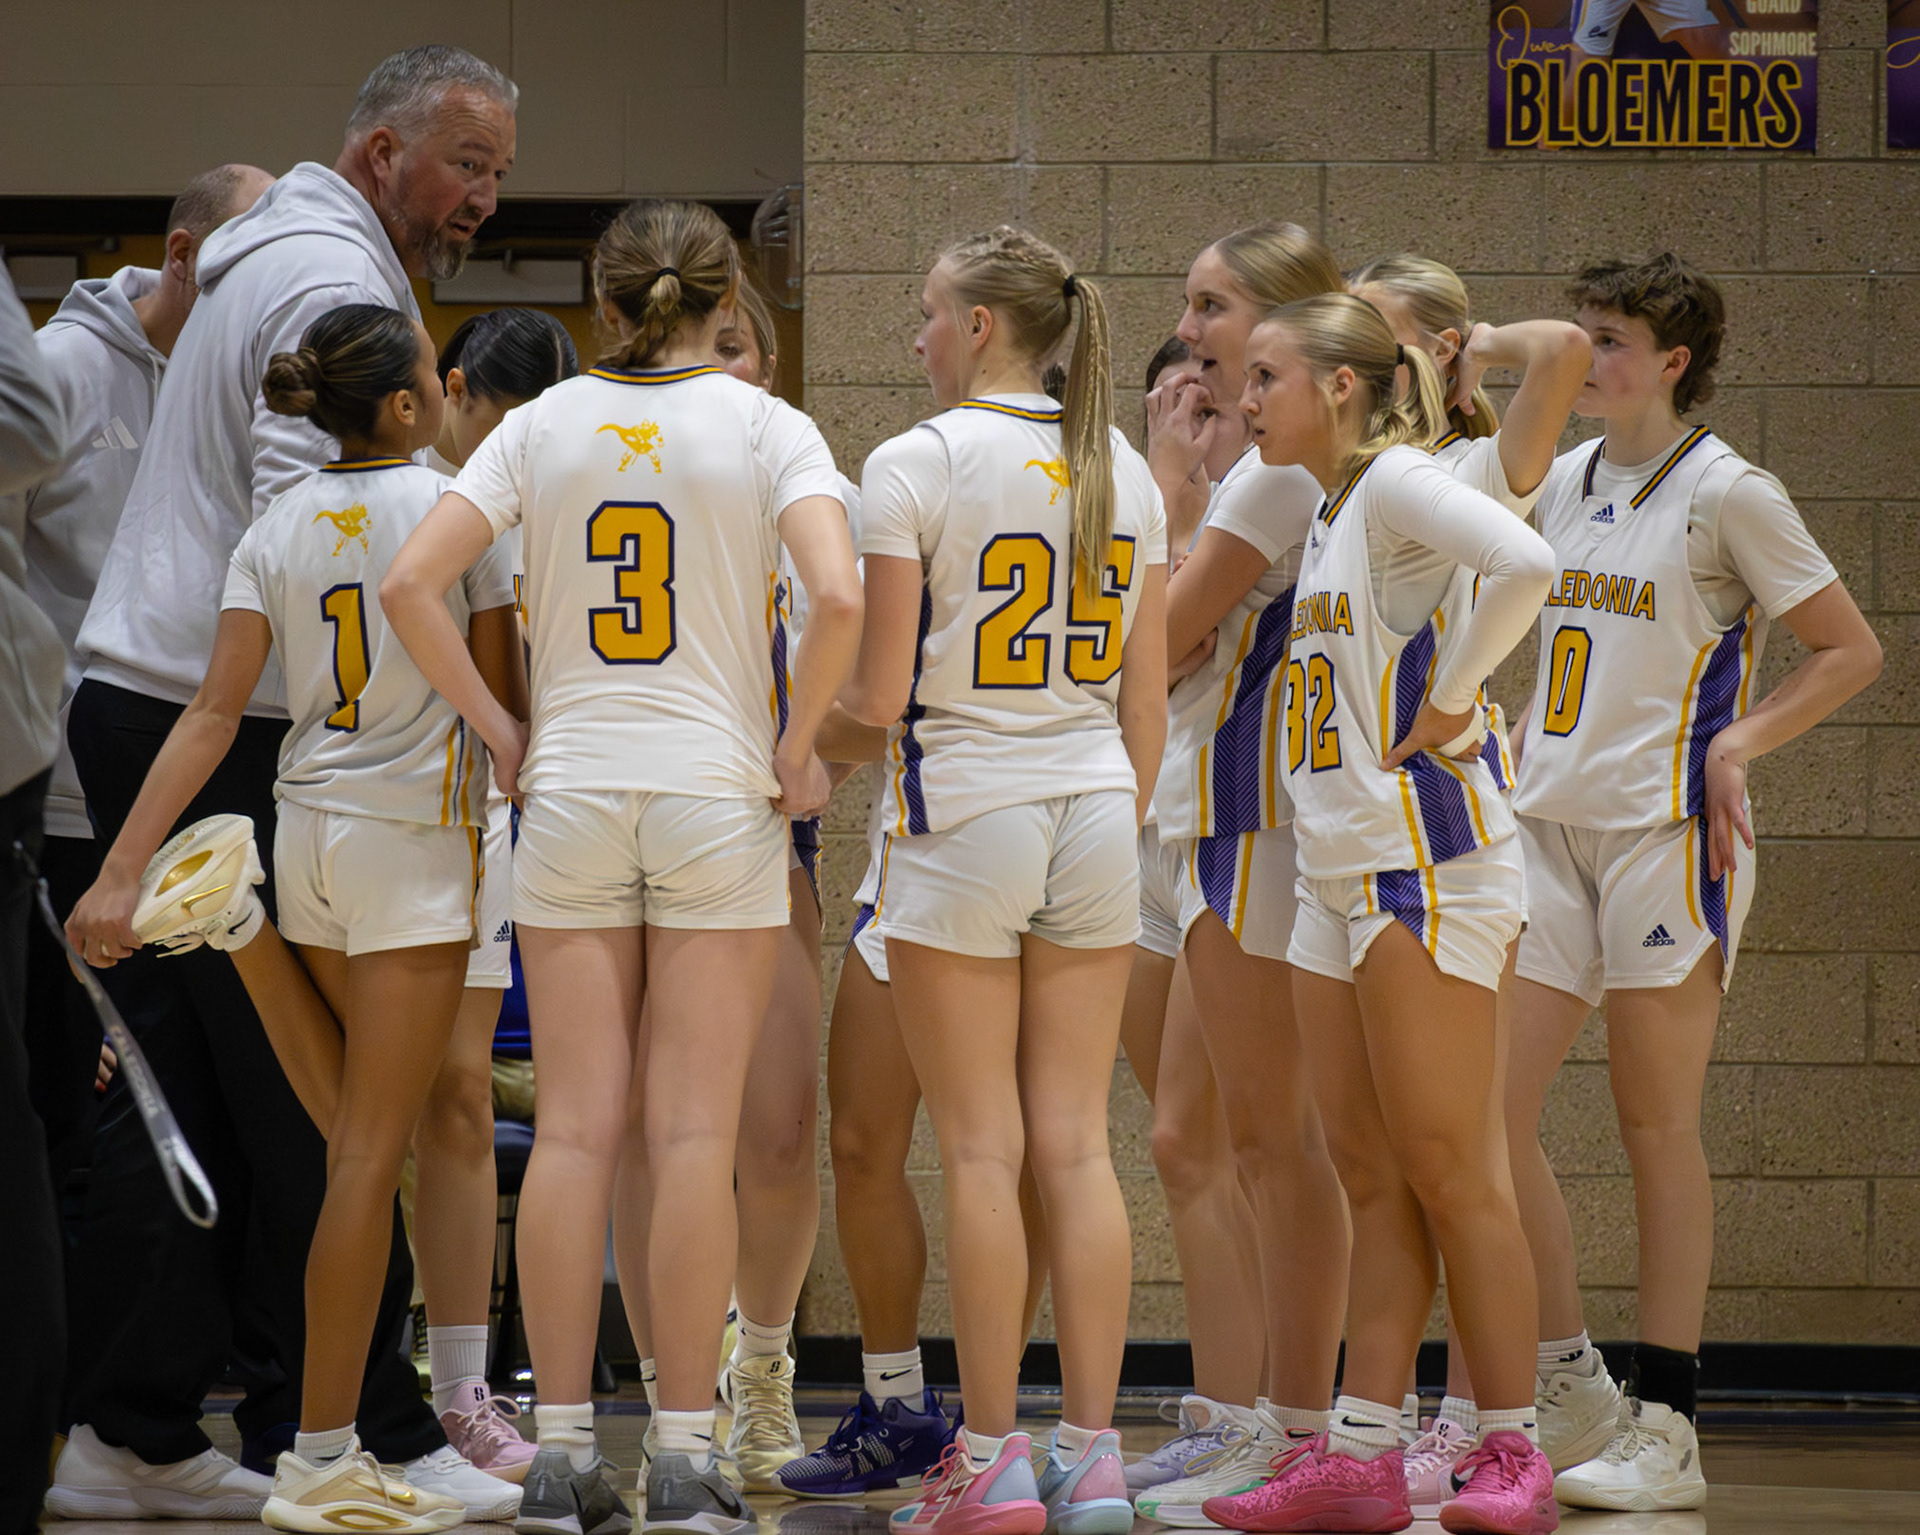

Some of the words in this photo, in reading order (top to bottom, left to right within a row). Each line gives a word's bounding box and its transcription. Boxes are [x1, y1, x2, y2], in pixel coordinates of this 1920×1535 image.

[1729, 31, 1818, 56] SOPHMORE
[1506, 59, 1802, 147] BLOEMERS
[587, 500, 677, 666] 3
[972, 533, 1136, 688] 25
[1544, 569, 1655, 621] LEDONIA
[320, 582, 372, 733] 1
[1287, 652, 1342, 776] 32
[1543, 625, 1593, 738] 0
[1642, 938, 1675, 947] adidas
